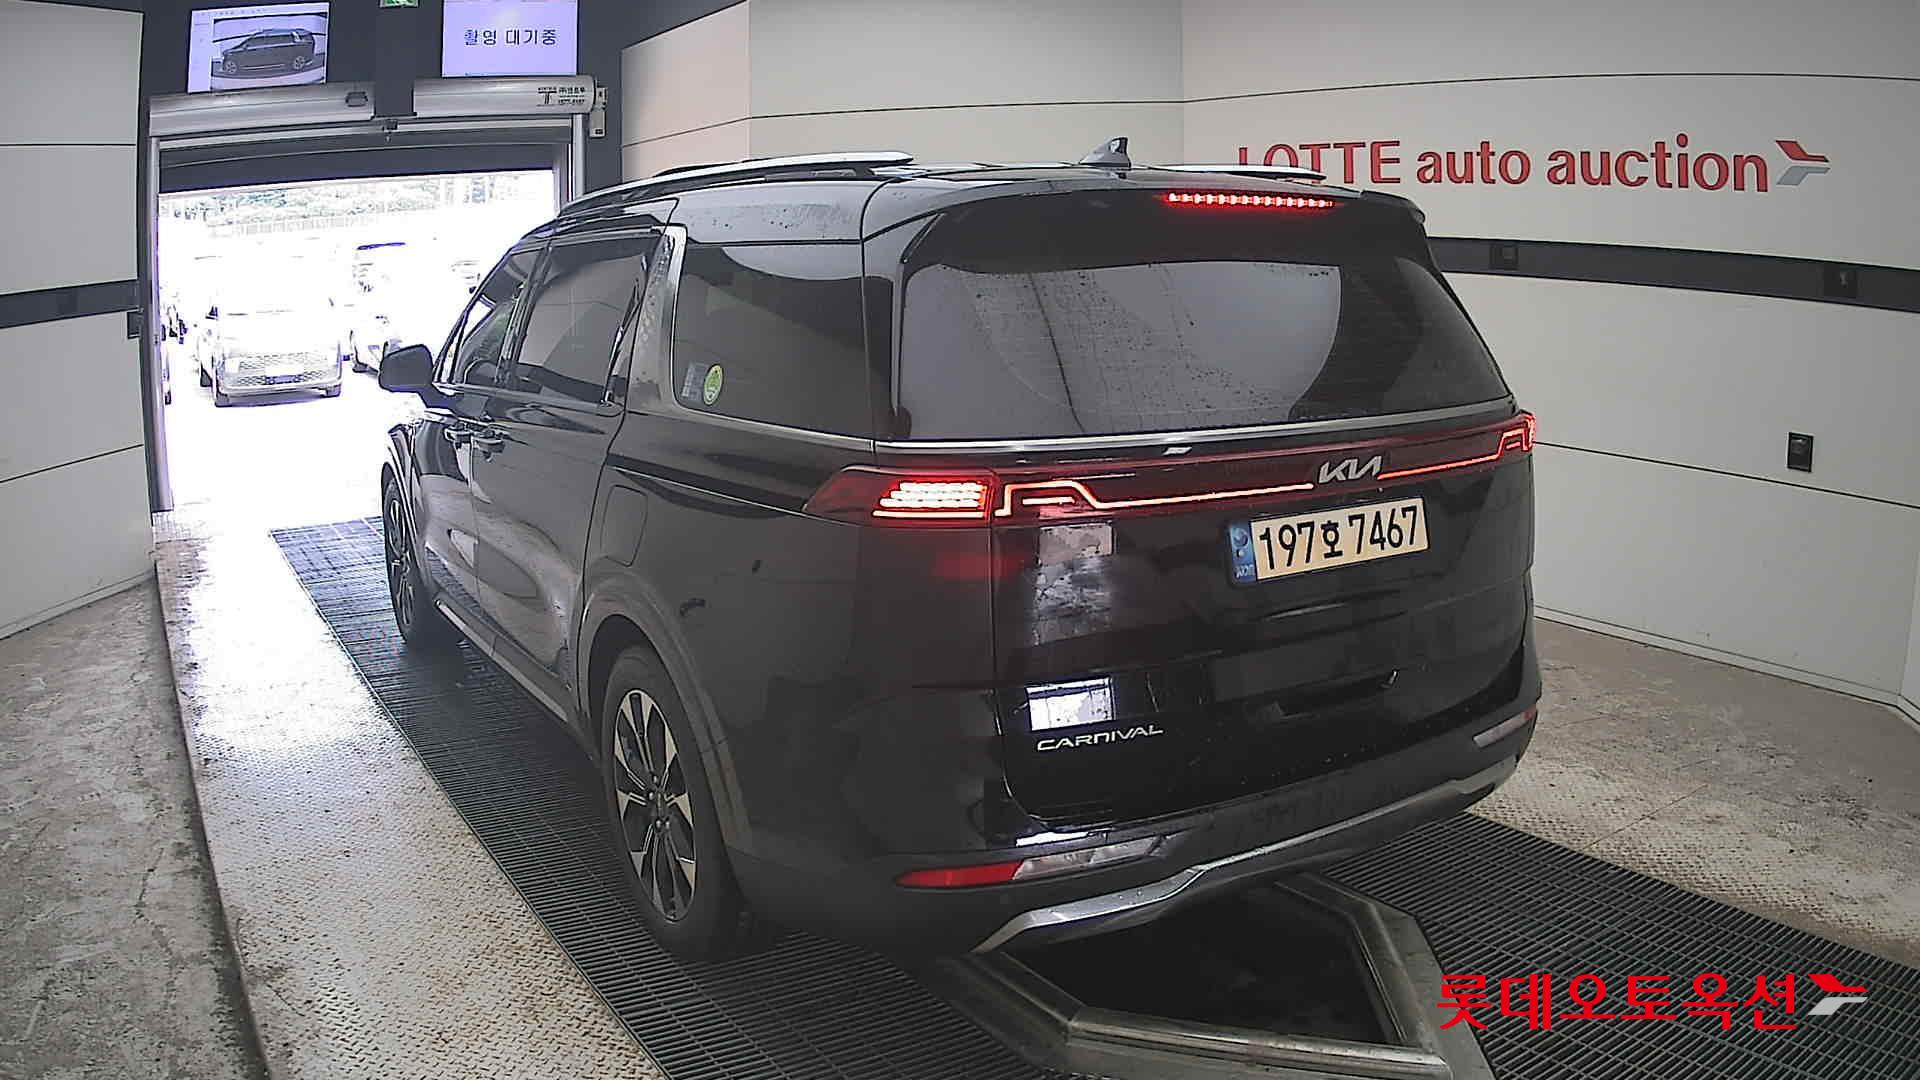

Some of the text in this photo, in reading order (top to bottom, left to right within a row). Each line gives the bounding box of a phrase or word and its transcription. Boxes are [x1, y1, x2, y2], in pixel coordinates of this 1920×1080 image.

[504, 29, 557, 46] 대기중
[1416, 141, 1531, 185] auto
[1547, 133, 1769, 192] auction
[1318, 455, 1383, 484] KIA
[1259, 505, 1418, 570] 197호 7467
[1037, 724, 1164, 752] CARNIVAL
